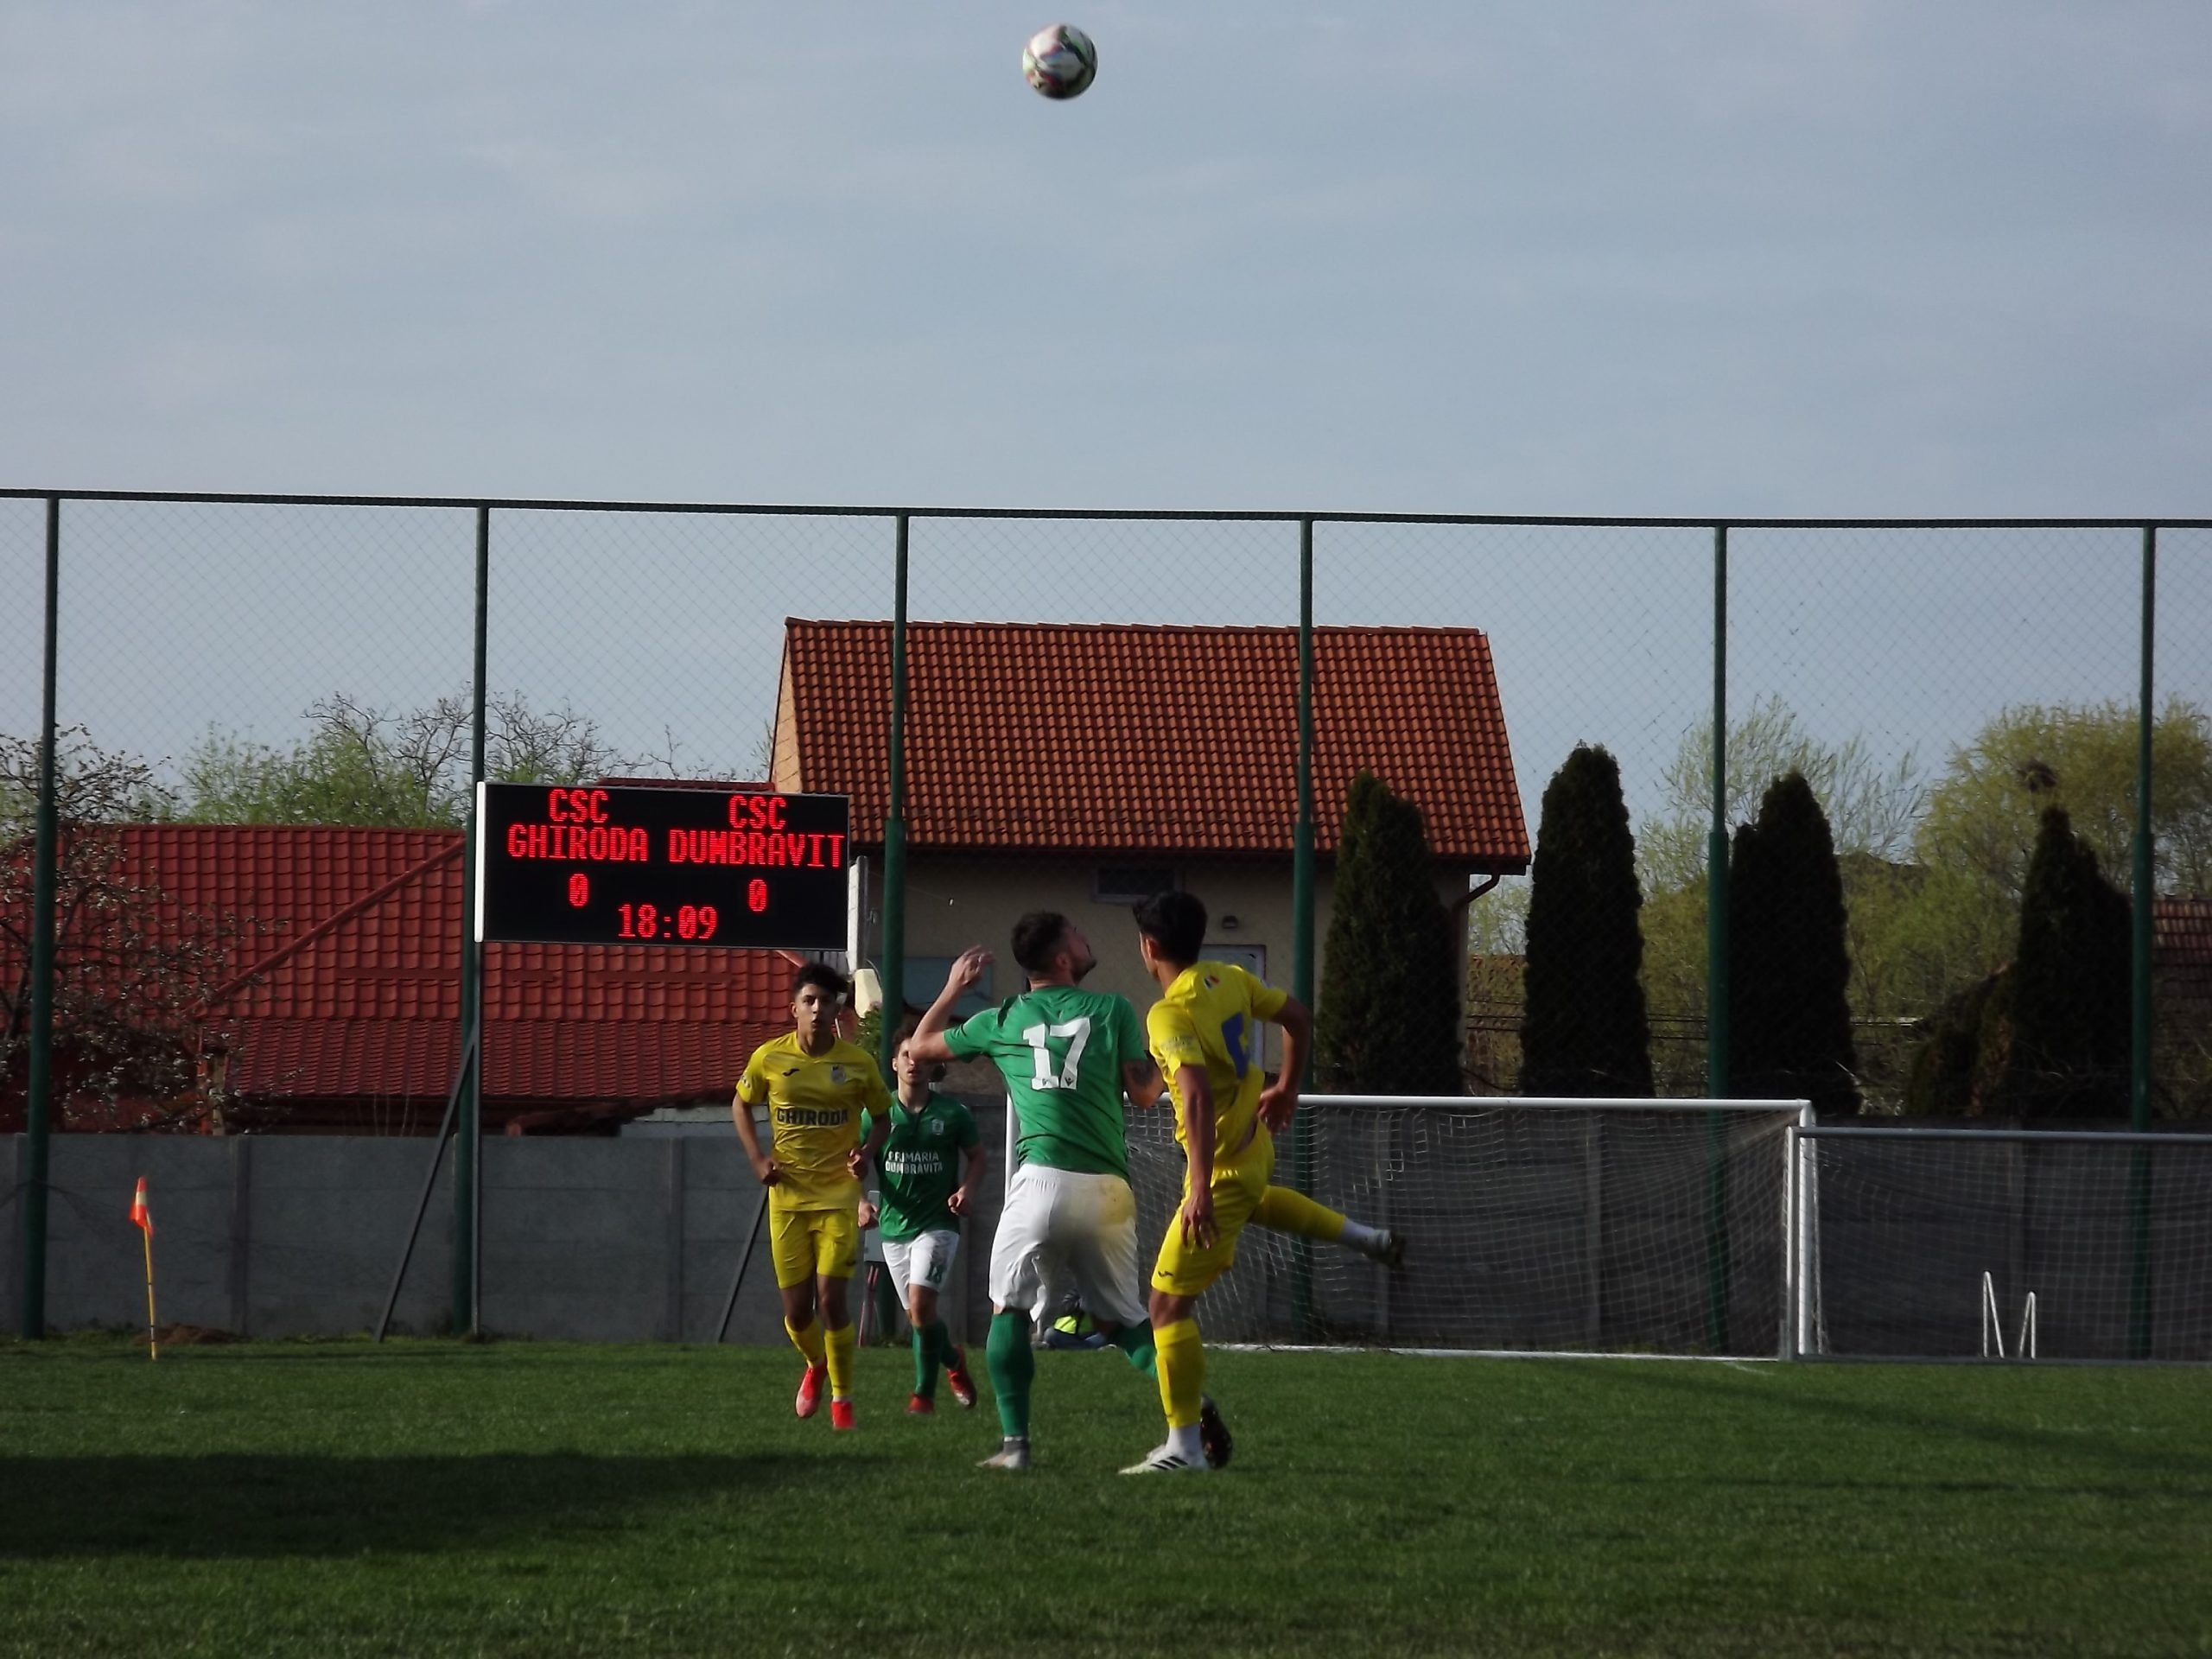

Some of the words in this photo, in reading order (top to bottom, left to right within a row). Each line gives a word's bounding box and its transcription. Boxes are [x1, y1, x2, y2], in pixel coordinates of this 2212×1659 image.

[550, 789, 608, 823] CSC
[729, 795, 787, 830] CSC
[508, 824, 647, 861] GHIRODA
[669, 829, 845, 868] DUMBRAVIT
[569, 874, 588, 906] 0
[748, 879, 767, 912] 0
[618, 904, 717, 939] 18:09
[1022, 1016, 1090, 1090] 17
[777, 1107, 848, 1126] GHIRODA
